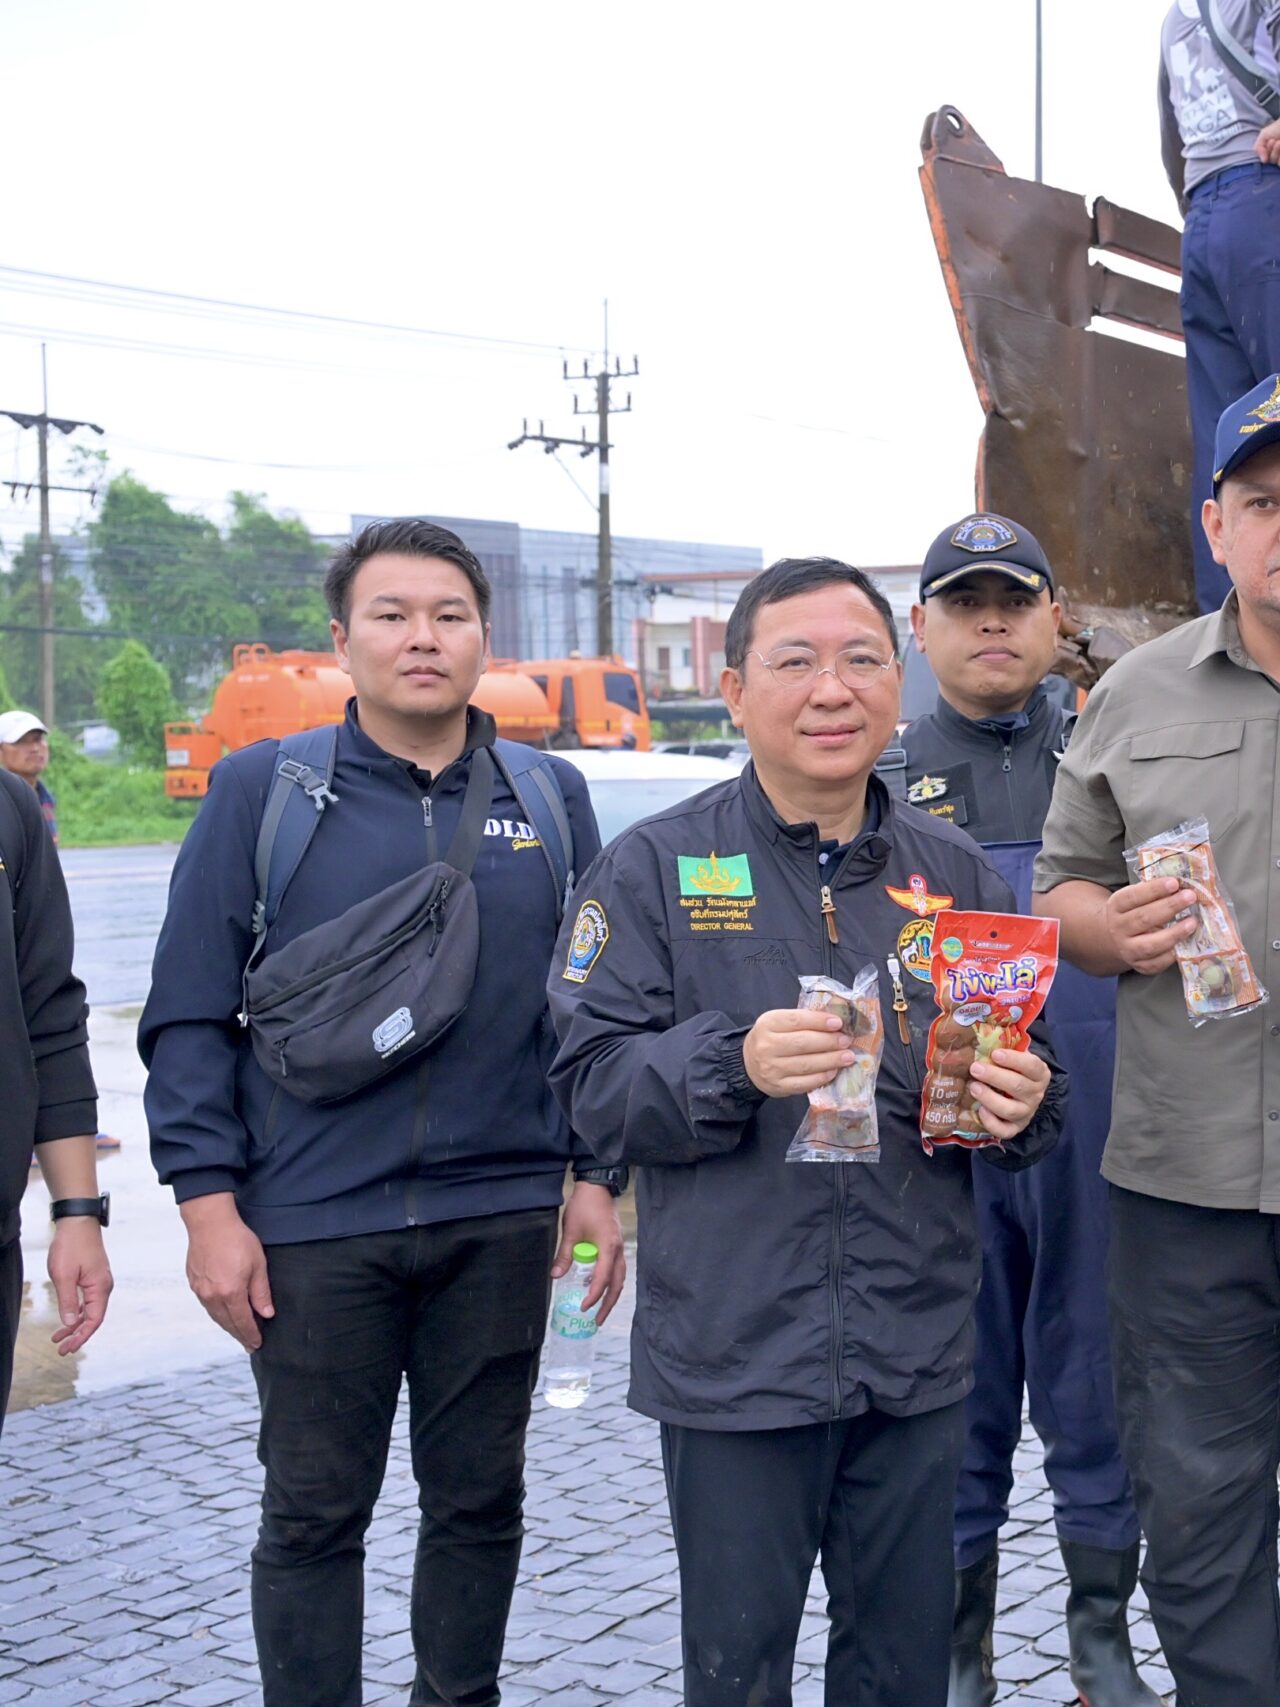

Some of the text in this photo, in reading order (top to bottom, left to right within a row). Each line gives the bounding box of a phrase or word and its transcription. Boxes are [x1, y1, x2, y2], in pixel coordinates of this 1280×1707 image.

[690, 922, 754, 931] DIRECTOR GENERAL
[946, 957, 1038, 1003] ไข่พะโล้
[930, 1087, 944, 1099] 10
[569, 1318, 596, 1329] Plus
